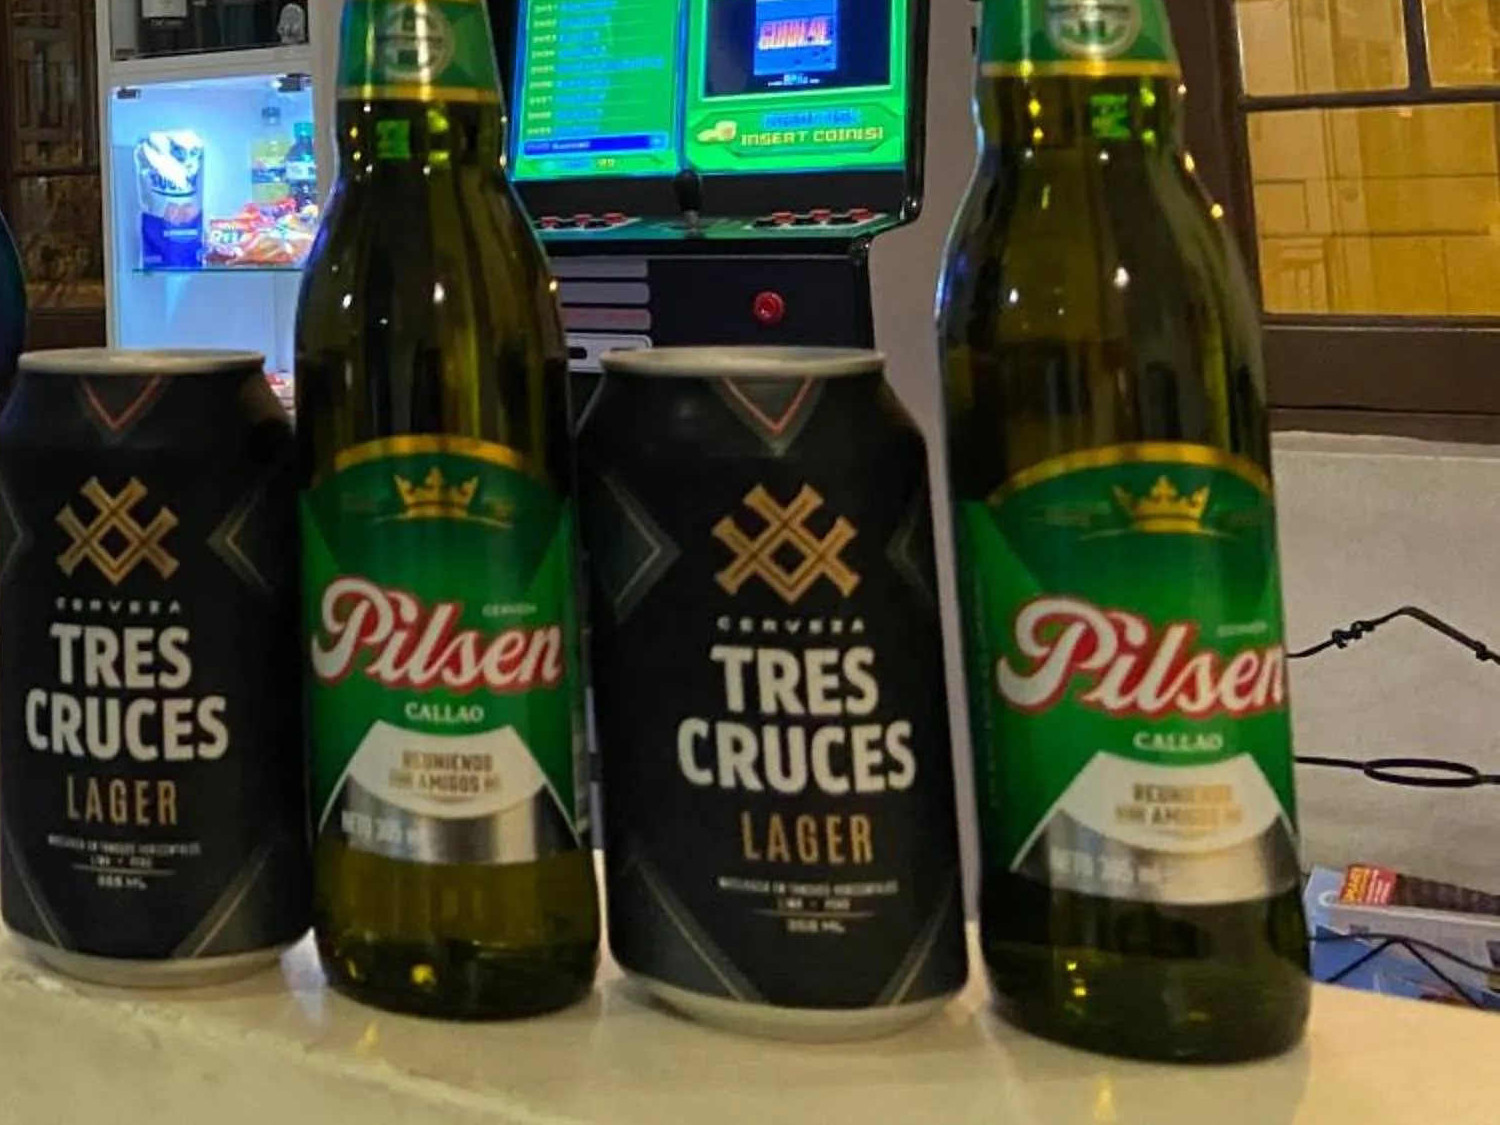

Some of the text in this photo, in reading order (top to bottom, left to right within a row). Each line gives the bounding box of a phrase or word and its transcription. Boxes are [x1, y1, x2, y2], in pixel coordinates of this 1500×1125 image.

[740, 129, 808, 147] INSERT
[49, 621, 193, 690] TRES
[310, 576, 565, 691] Pilsen
[995, 596, 1286, 715] Pilsen
[404, 701, 486, 723] CALLAO
[709, 643, 880, 716] TRES
[25, 688, 229, 761] CRUCES
[676, 716, 917, 795] CRUCES
[66, 774, 178, 825] LAGER
[740, 809, 875, 865] LAGER
